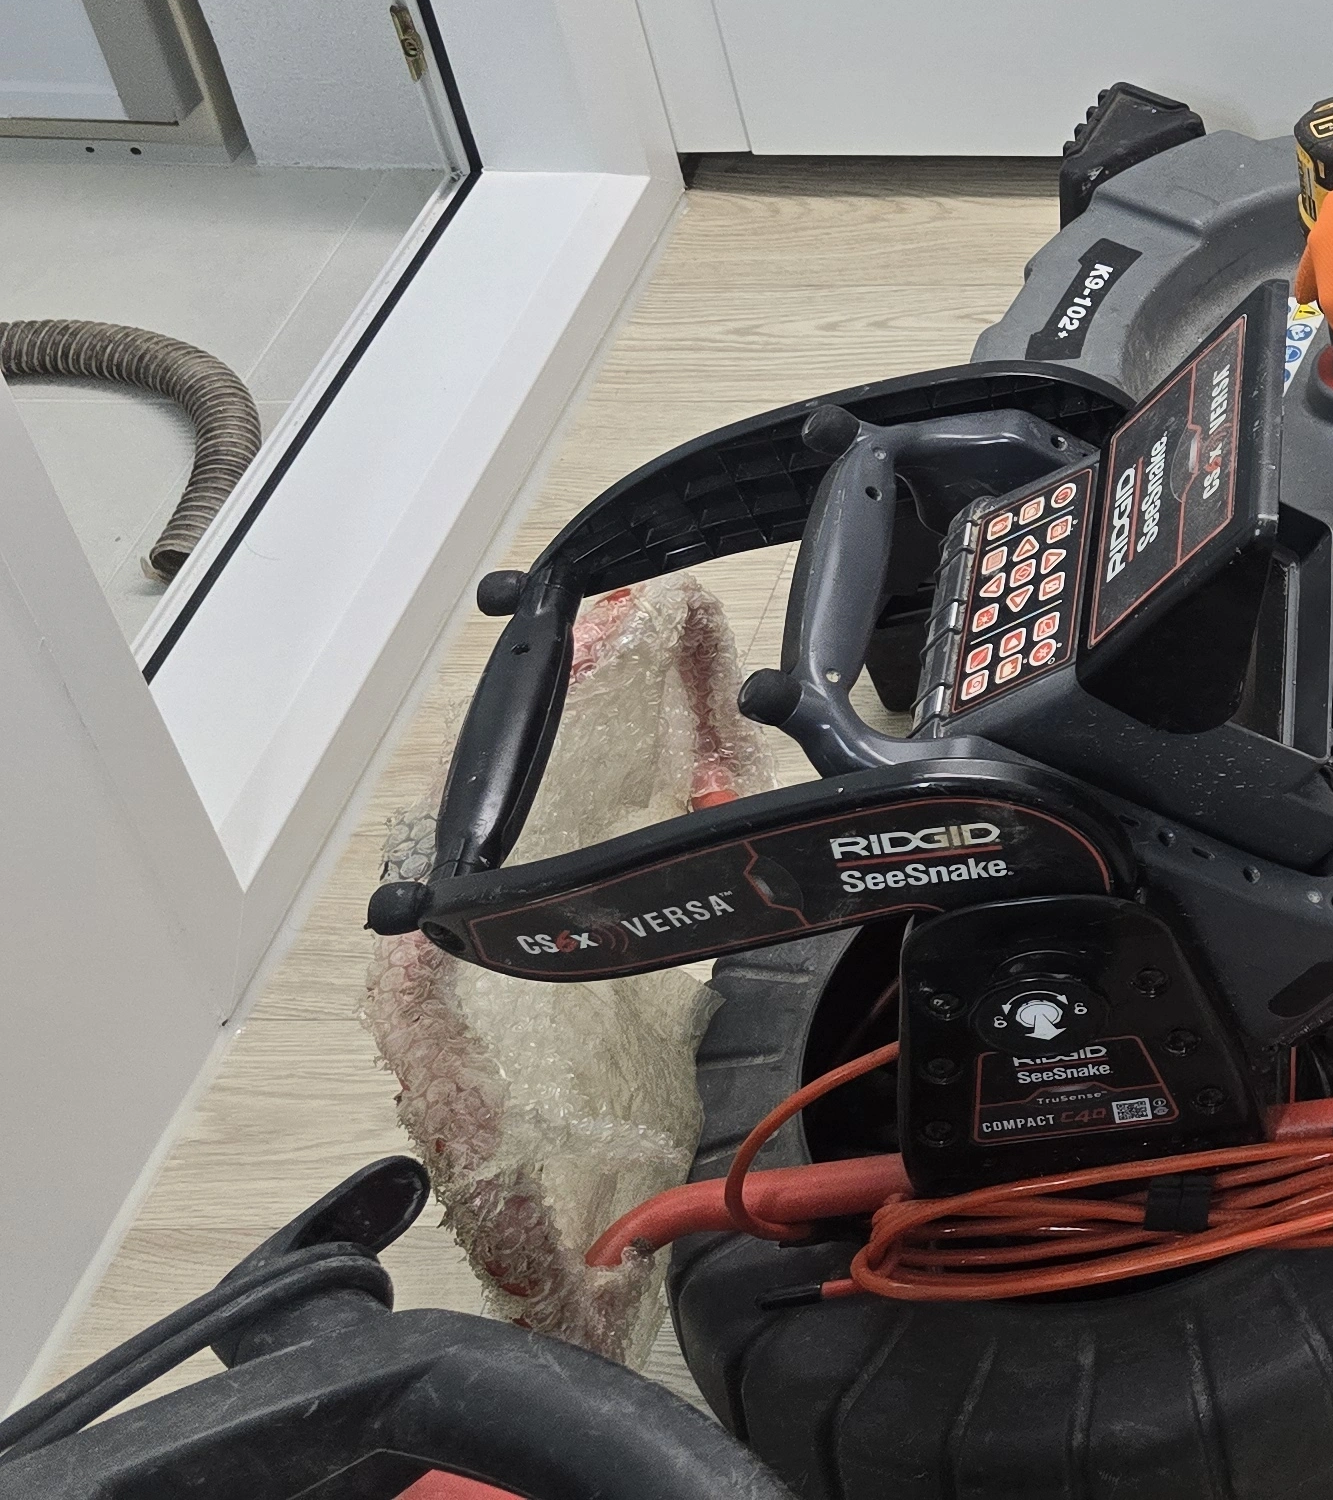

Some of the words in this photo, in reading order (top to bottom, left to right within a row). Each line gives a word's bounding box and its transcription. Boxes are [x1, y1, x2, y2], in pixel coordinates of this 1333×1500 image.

[1058, 263, 1114, 338] K9-102+
[1209, 364, 1231, 435] VERSA
[1136, 430, 1168, 553] SeeSnake
[1106, 464, 1137, 583] RIDGID
[830, 822, 1001, 860] RIDGID
[840, 857, 1014, 893] SeeSnake
[516, 929, 599, 955] CS6x
[1016, 1063, 1113, 1084] SeeSnake
[982, 1114, 1055, 1133] COMPACT
